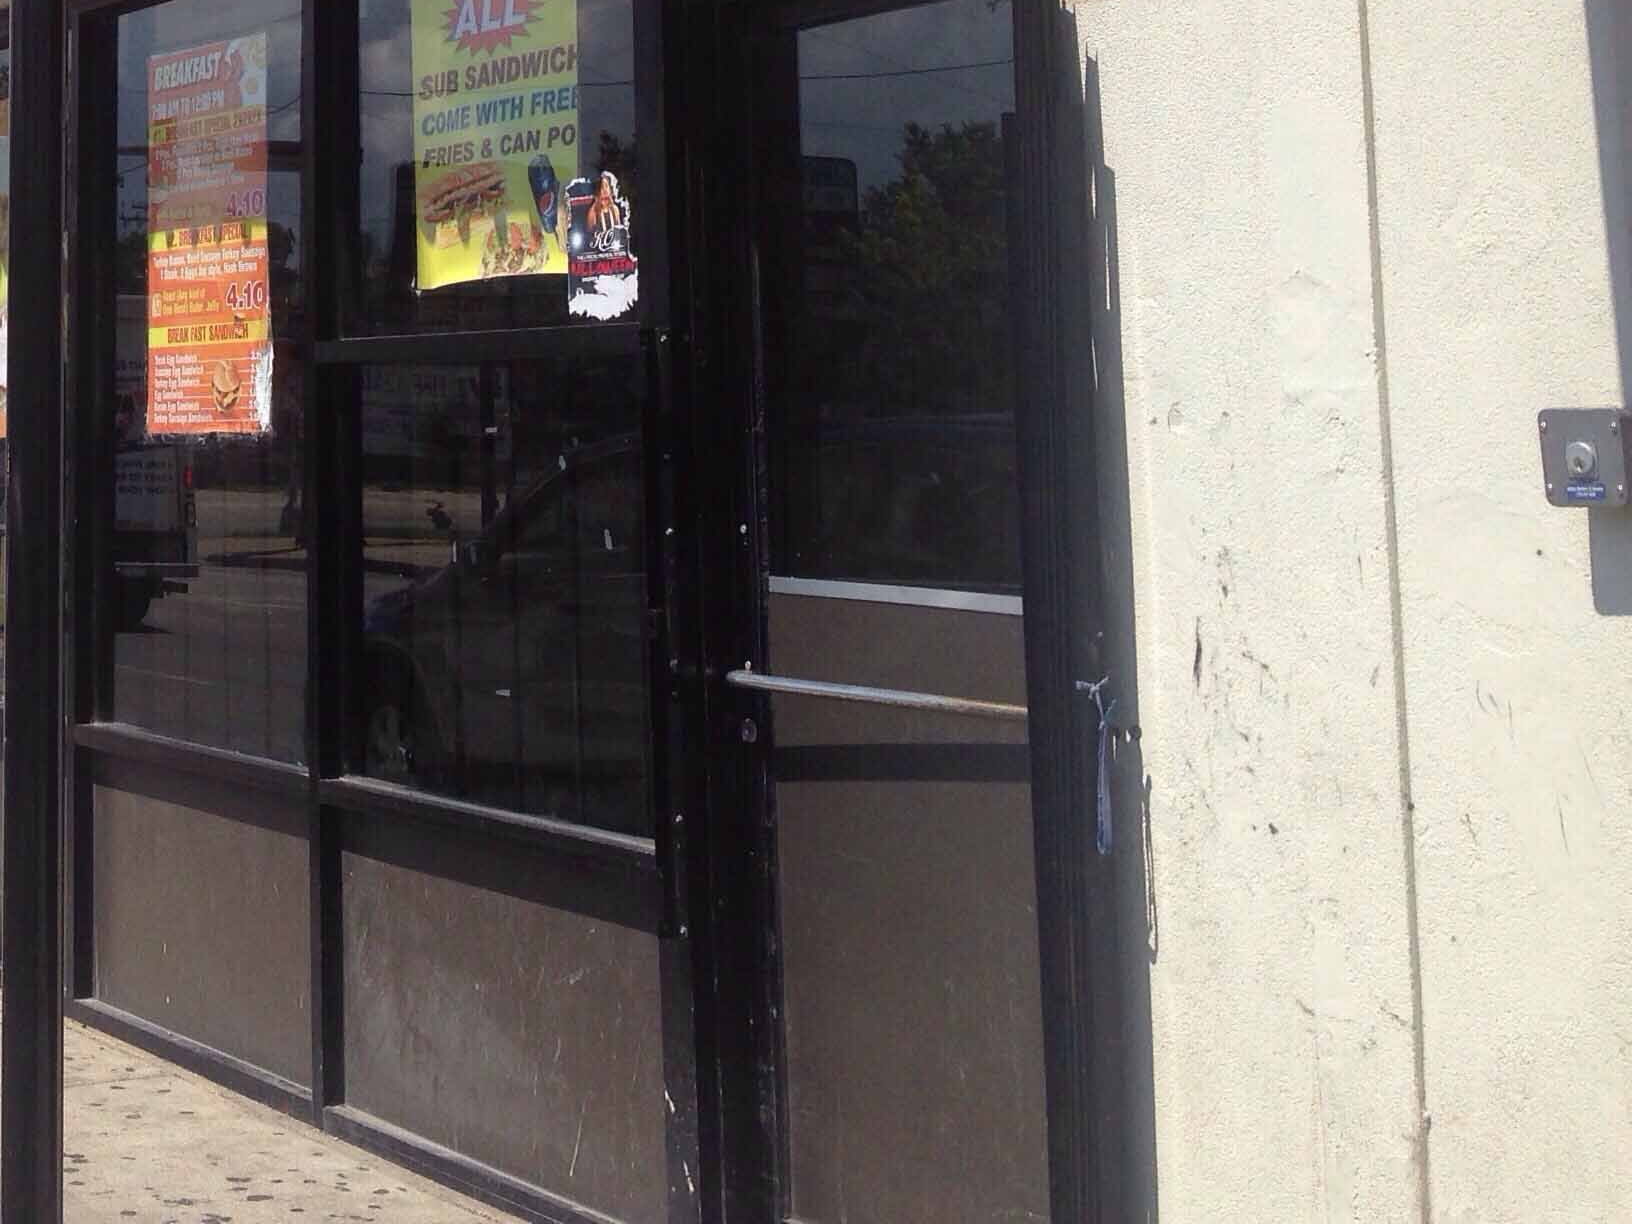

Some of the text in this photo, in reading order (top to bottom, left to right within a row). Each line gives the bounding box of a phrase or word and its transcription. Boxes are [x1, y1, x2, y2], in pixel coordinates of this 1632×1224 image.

[154, 51, 222, 92] BREAKFAST
[419, 70, 459, 101] SUB
[421, 106, 471, 137] COME
[475, 95, 525, 126] WITH
[423, 141, 475, 169] FRIES
[500, 129, 541, 155] CAN
[226, 280, 266, 310] 4.10
